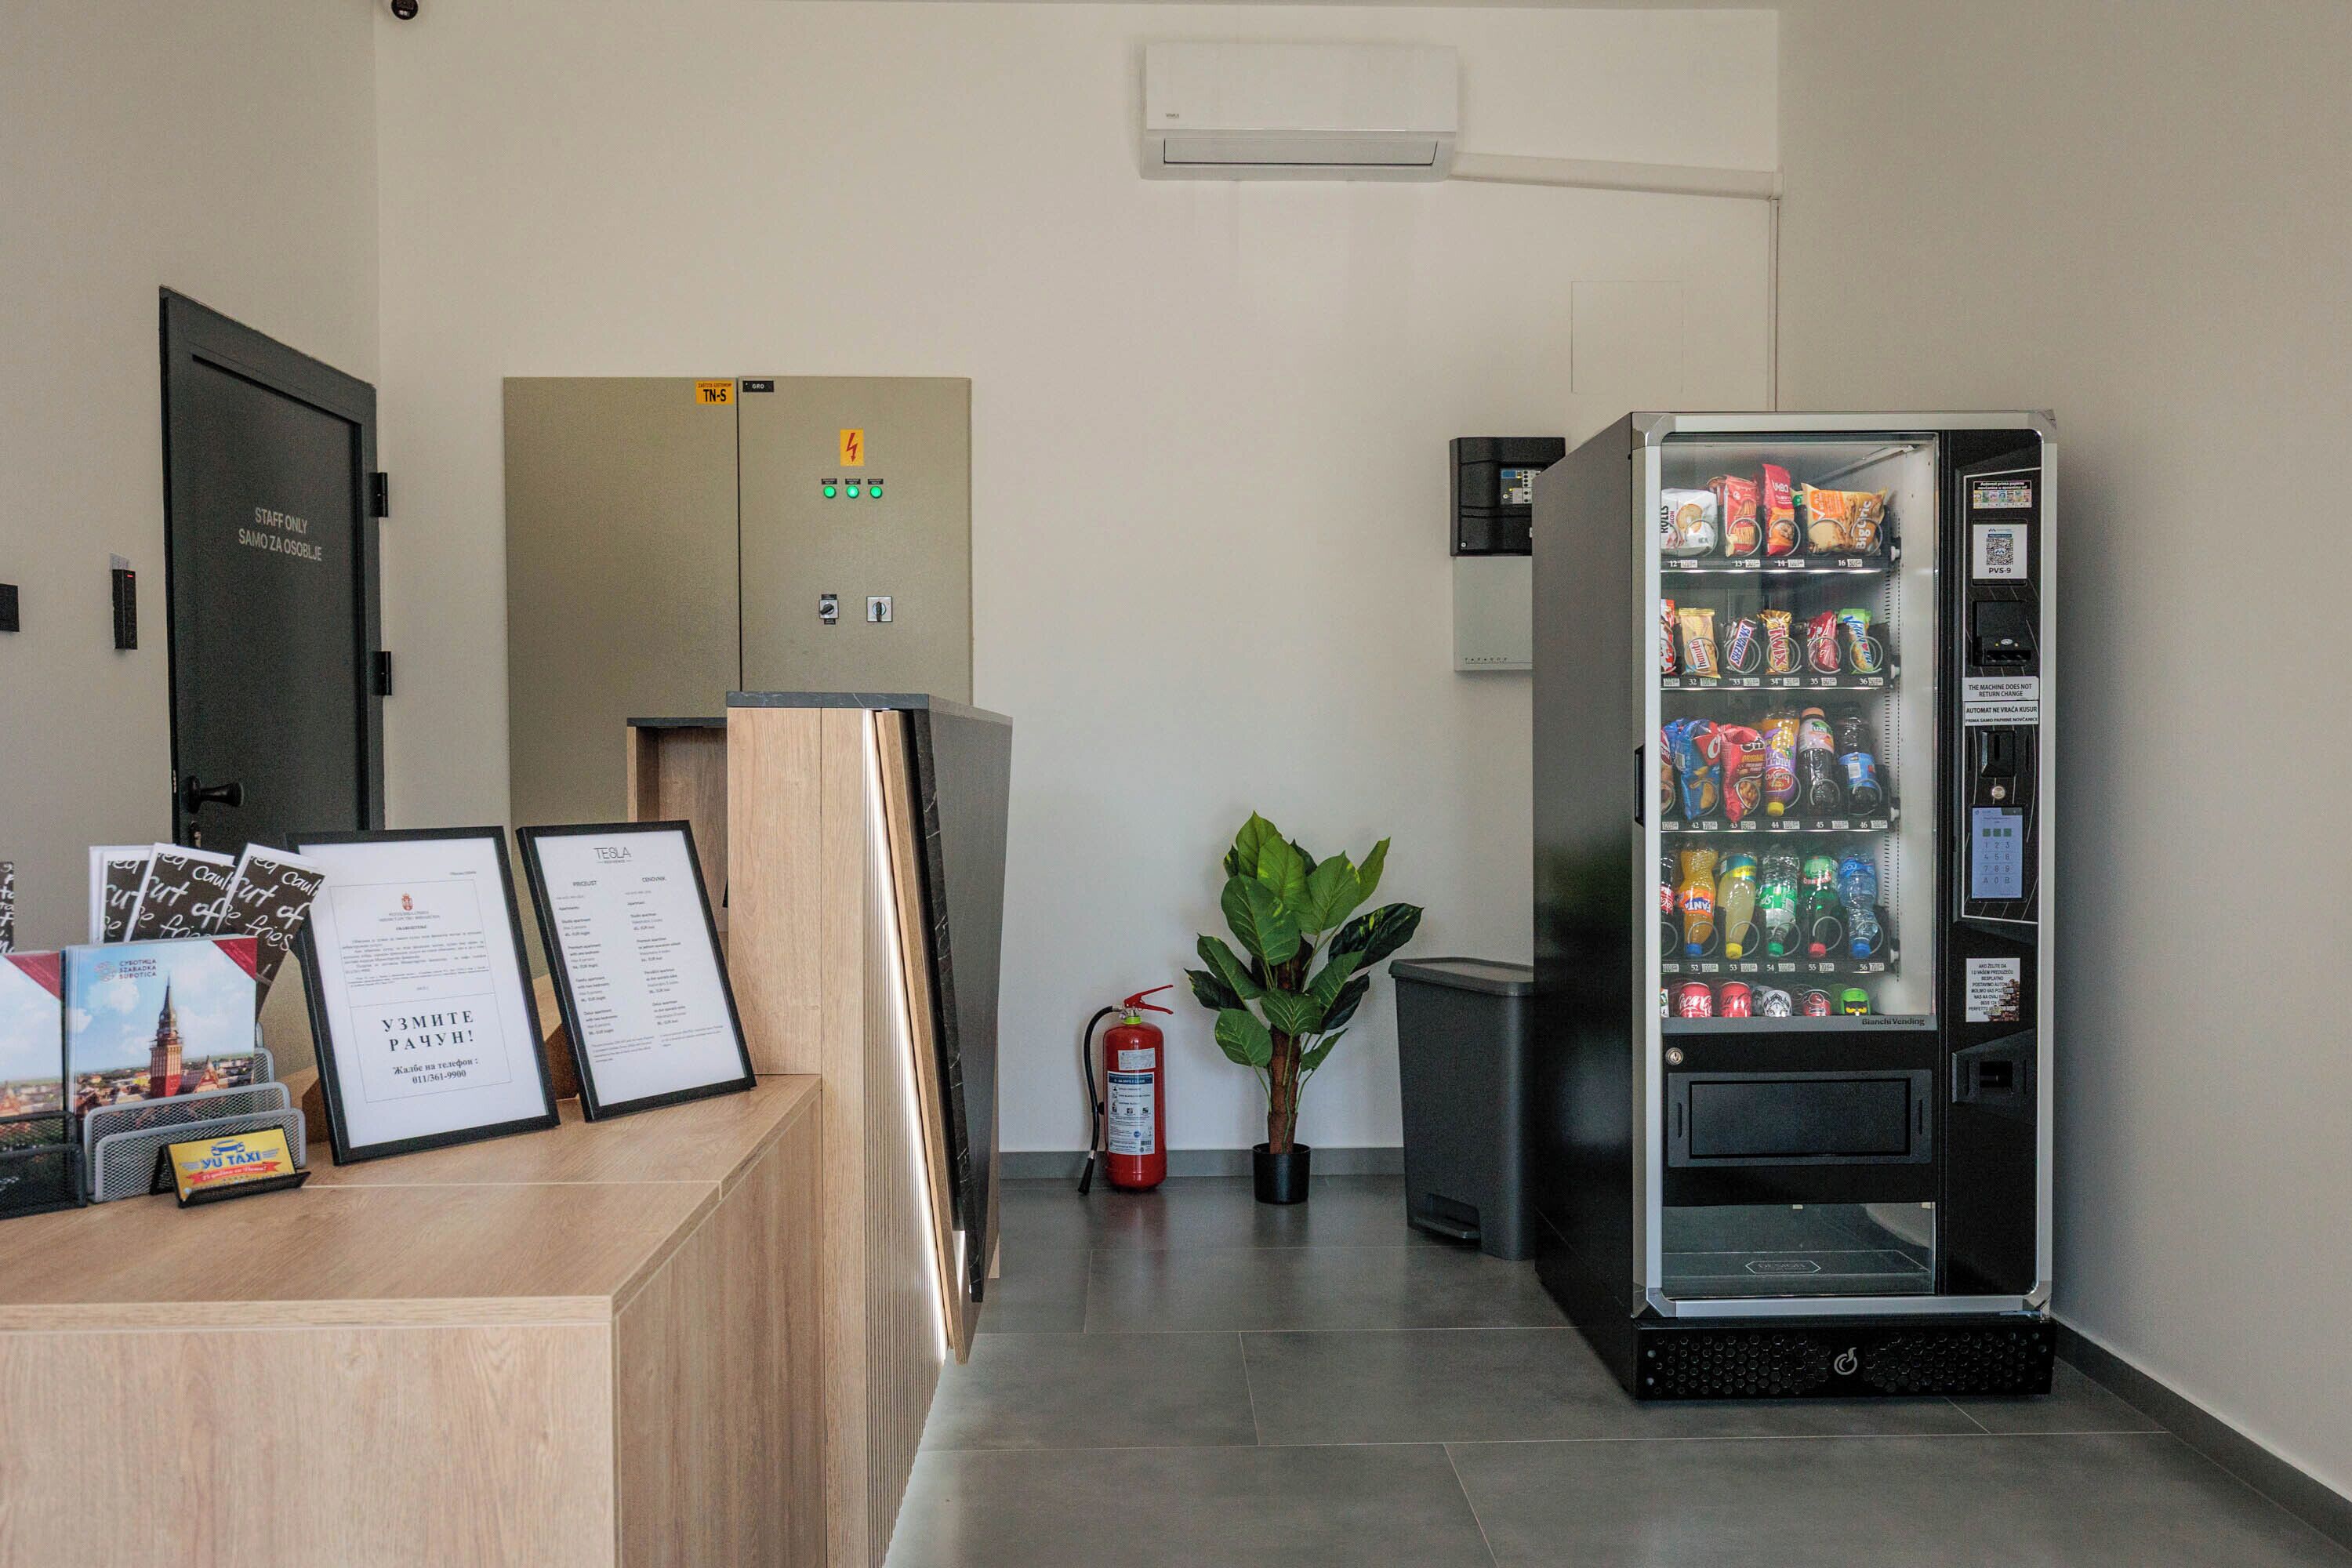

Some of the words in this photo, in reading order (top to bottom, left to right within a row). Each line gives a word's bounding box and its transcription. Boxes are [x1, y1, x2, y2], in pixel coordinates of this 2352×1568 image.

[703, 389, 727, 402] TN-S
[255, 507, 283, 528] STAFF
[285, 514, 307, 534] ONLY
[238, 528, 268, 549] SAMO
[269, 535, 283, 553] ZA
[284, 539, 322, 561] OSOBLJE
[1769, 627, 1788, 666] TWIX
[593, 846, 632, 861] TESLA
[276, 902, 311, 930] of
[1684, 898, 1711, 913] FANTA
[244, 915, 294, 952] fries
[381, 1011, 474, 1033] УЗМИТЕ
[389, 1030, 475, 1052] РАЧУН!
[393, 1064, 423, 1075] Жалбе
[438, 1058, 473, 1069] телефон
[412, 1069, 467, 1084] 011/361-9900
[200, 1158, 223, 1170] YU
[227, 1151, 261, 1166] TAXI
